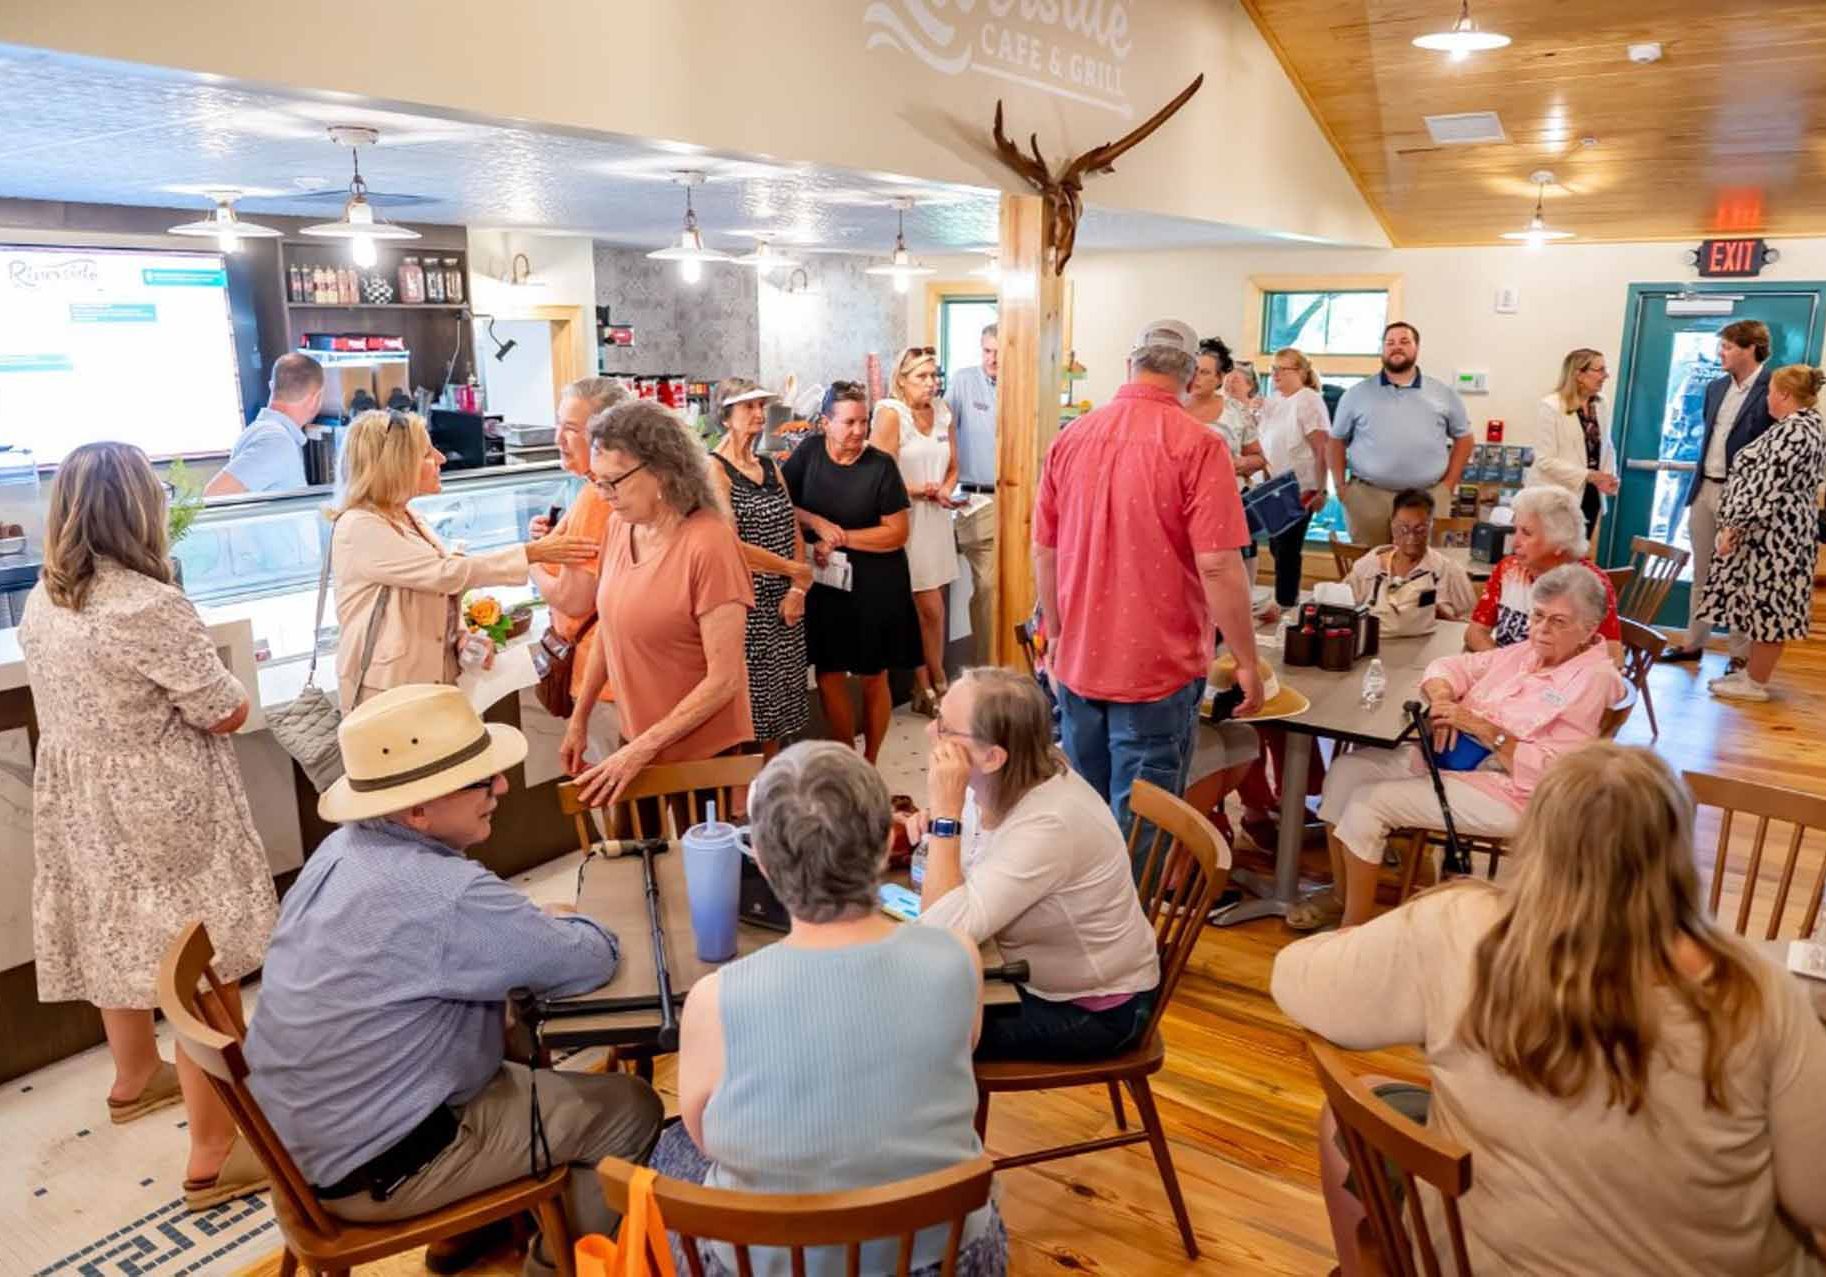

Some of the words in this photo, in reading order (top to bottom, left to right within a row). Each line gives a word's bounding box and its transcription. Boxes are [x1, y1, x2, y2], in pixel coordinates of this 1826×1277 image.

[1049, 46, 1063, 78] &
[1070, 53, 1125, 98] GRILL
[1709, 241, 1757, 273] EXIT
